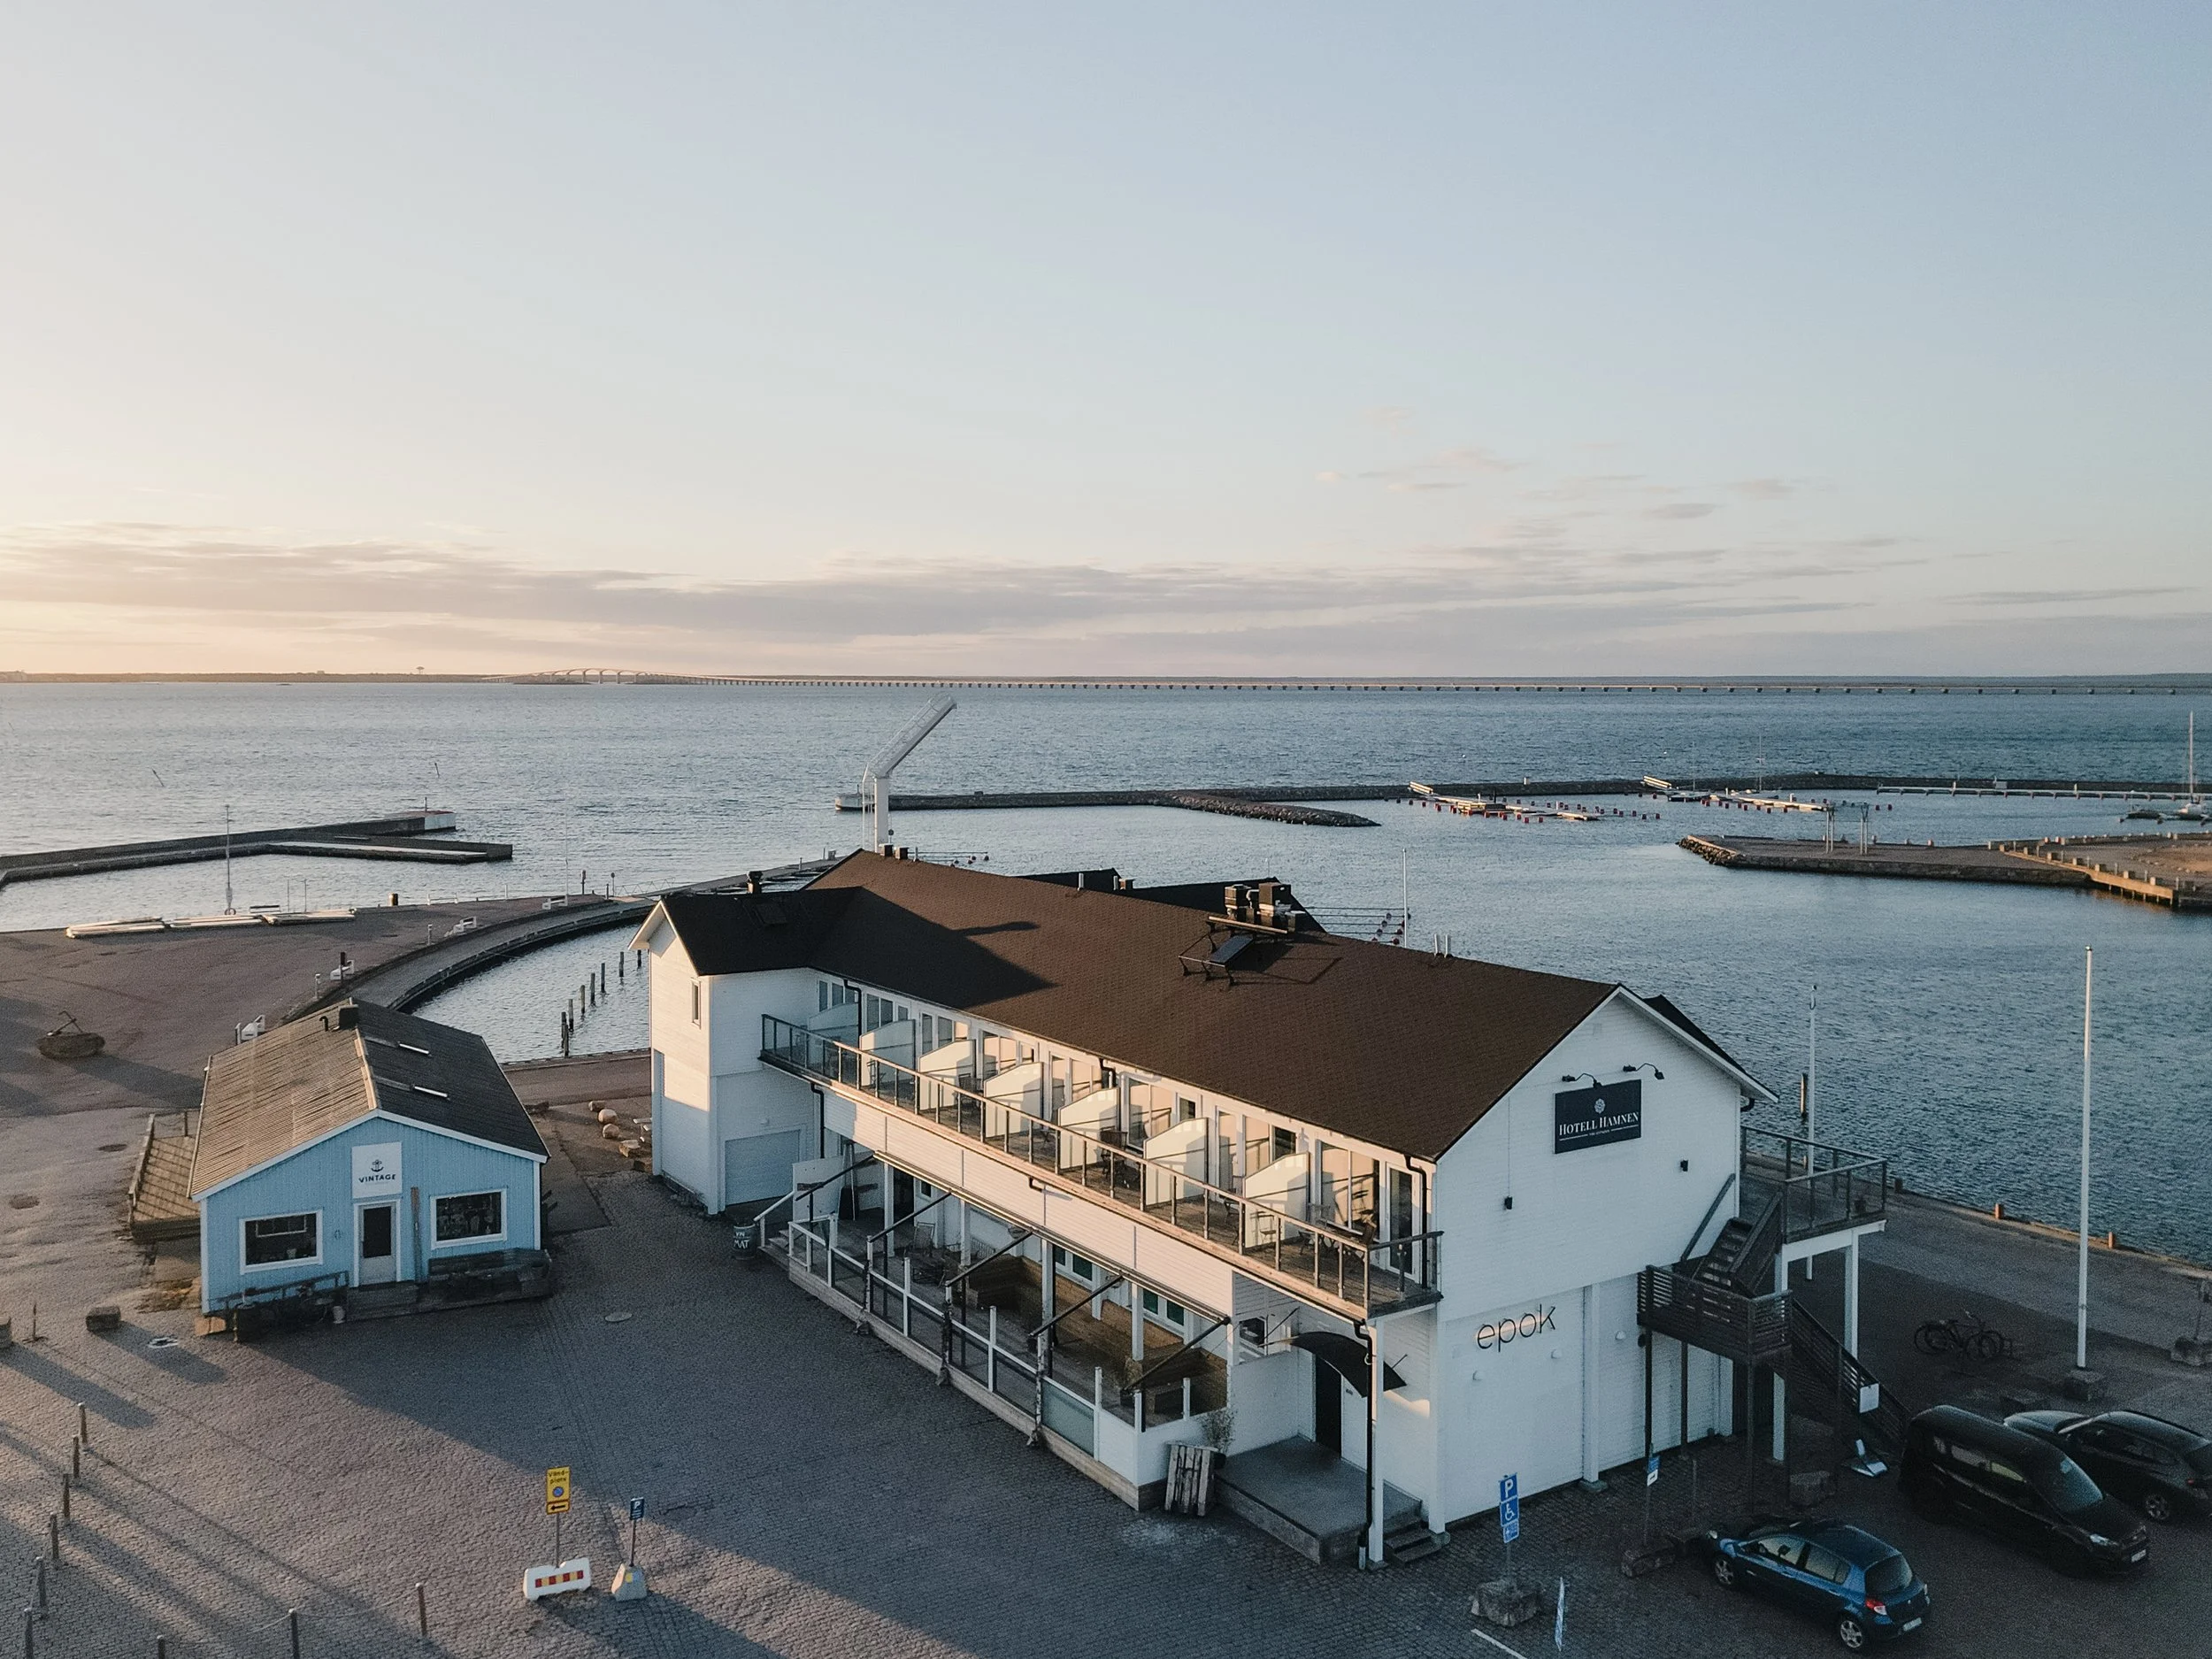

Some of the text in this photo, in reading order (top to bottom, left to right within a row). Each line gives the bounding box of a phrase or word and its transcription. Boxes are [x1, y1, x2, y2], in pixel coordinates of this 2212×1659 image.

[1559, 1119, 1598, 1136] HOTELL
[1599, 1111, 1640, 1128] HAMNEN
[358, 1173, 396, 1183] VINTAGE
[733, 1240, 750, 1249] MAT
[1477, 1303, 1555, 1353] epok
[1504, 1479, 1514, 1499] P
[634, 1501, 641, 1509] P
